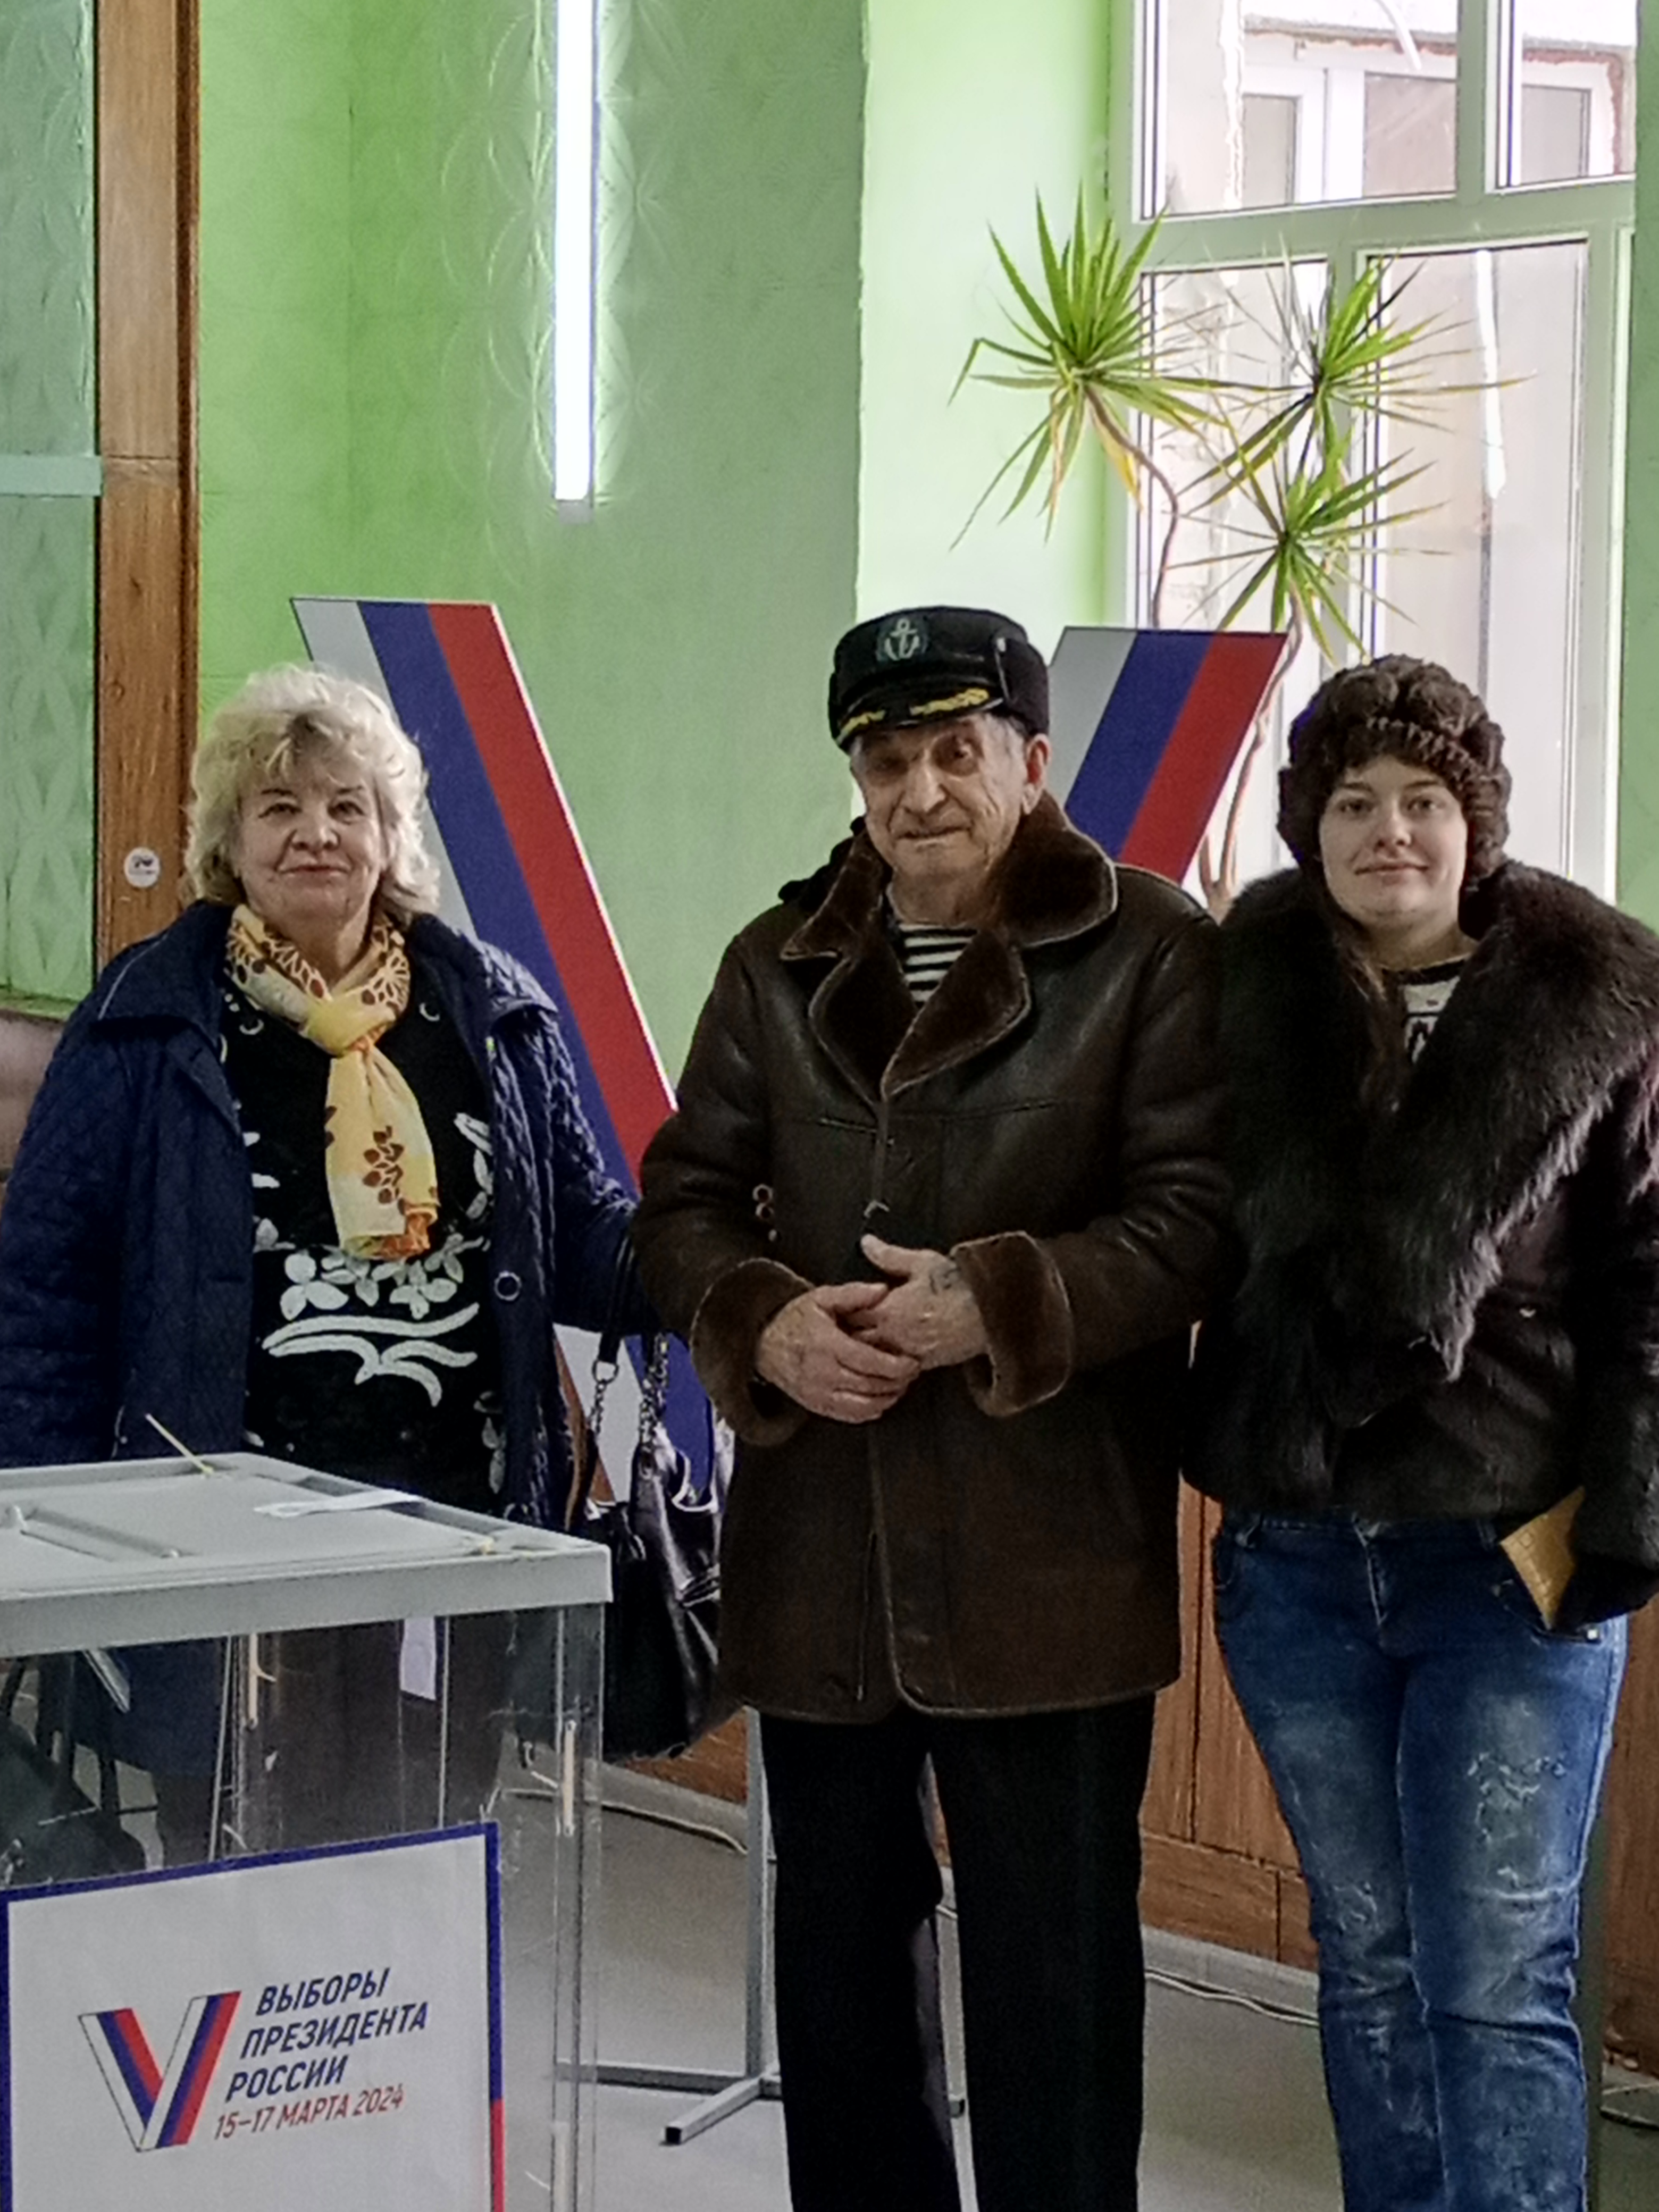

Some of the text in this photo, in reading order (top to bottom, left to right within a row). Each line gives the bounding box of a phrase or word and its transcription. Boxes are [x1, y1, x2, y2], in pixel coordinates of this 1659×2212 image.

[255, 1967, 390, 2016] ВЫБОРЫ
[239, 2001, 429, 2059] ПРЕЗИДЕНТА
[224, 2054, 349, 2104] РОССИИ
[275, 2093, 349, 2130] МАРТА
[351, 2083, 404, 2117] 2024
